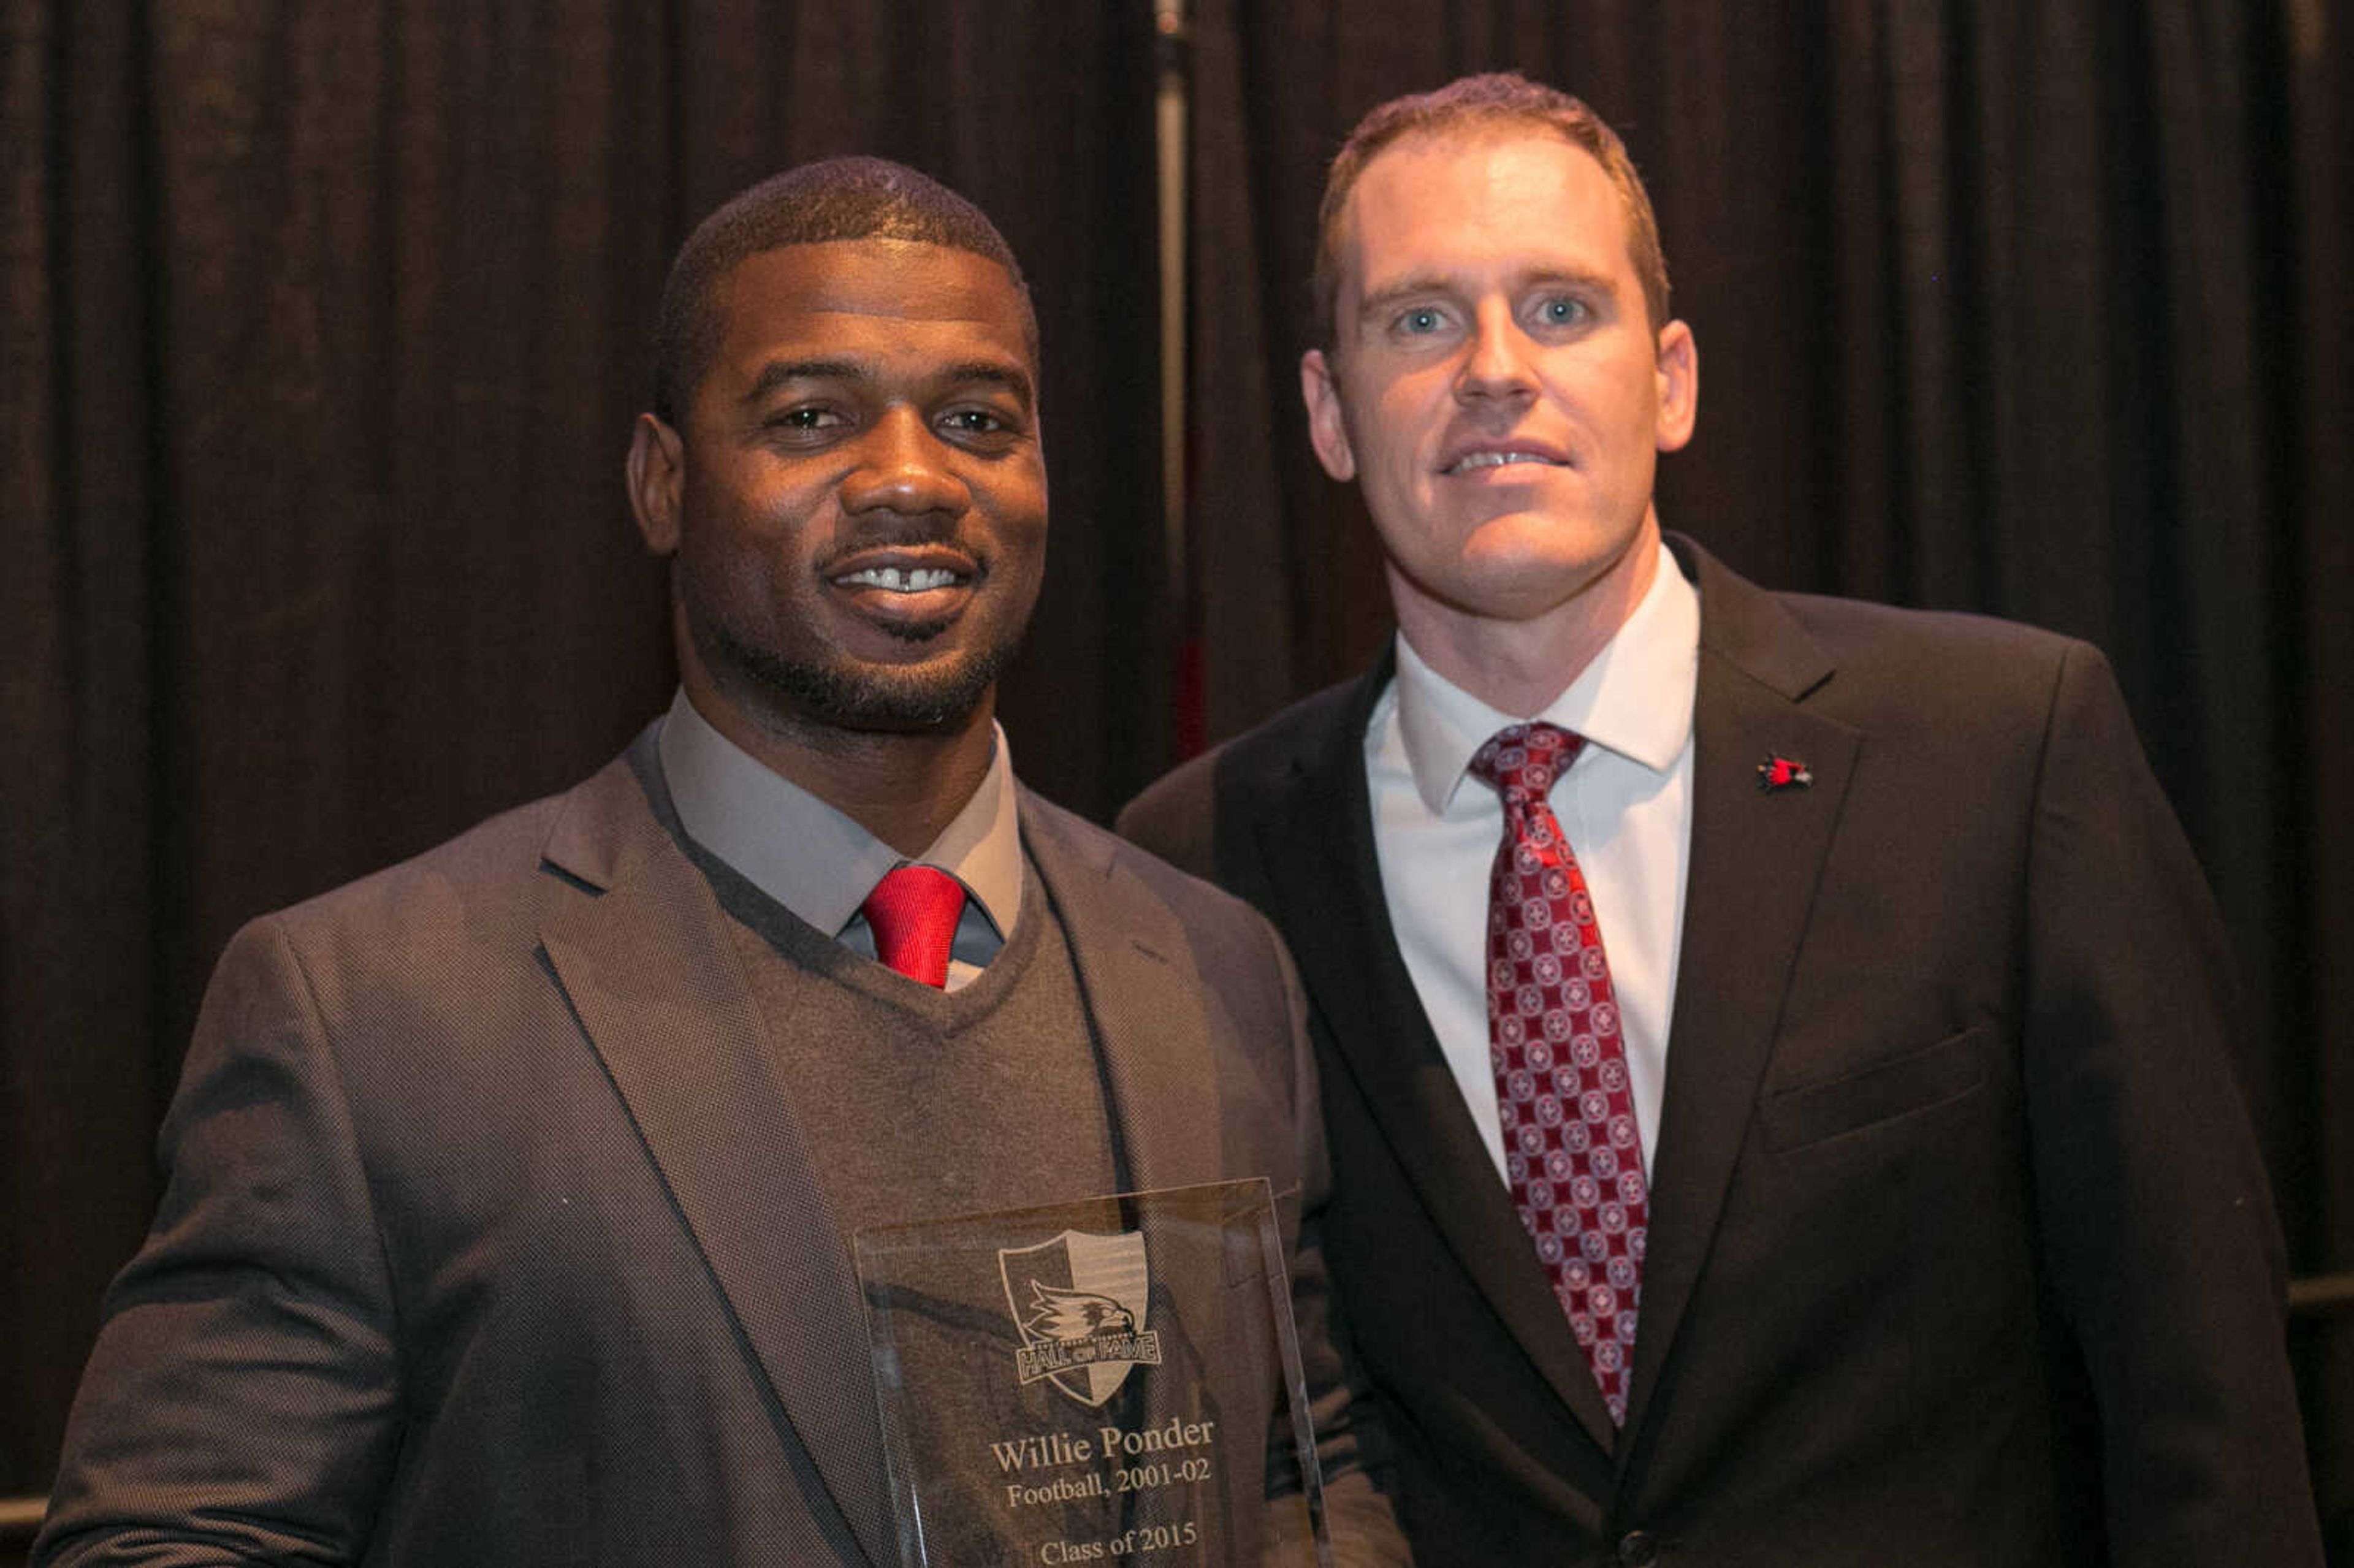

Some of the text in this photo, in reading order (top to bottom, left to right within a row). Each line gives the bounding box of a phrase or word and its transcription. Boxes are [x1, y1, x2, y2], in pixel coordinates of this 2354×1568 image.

[1021, 1348, 1072, 1378] HALL
[1099, 1335, 1157, 1360] FAME
[990, 1418, 1213, 1472] Willie Ponder
[1007, 1458, 1211, 1507] Football, 2001-02
[1041, 1522, 1197, 1565] Class of 2015
